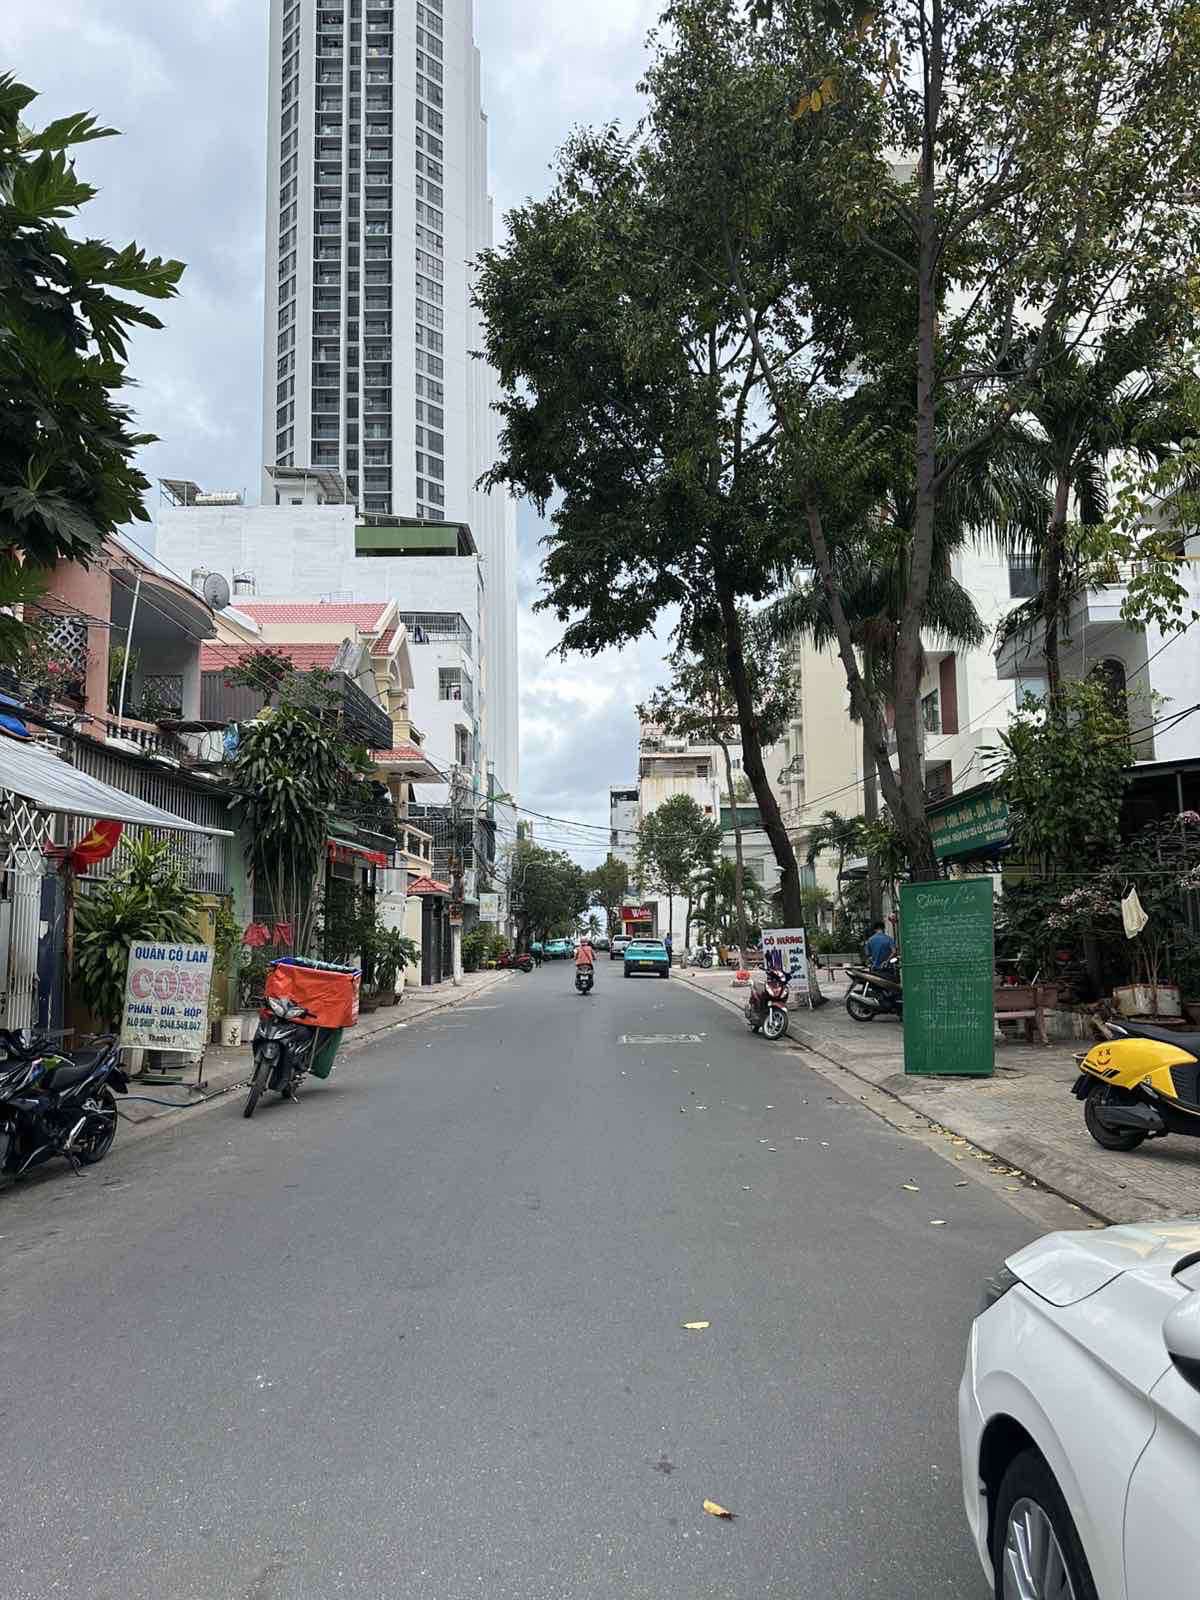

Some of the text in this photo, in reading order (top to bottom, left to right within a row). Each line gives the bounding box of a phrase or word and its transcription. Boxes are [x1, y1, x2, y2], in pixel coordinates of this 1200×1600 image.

[135, 945, 208, 963] QUÁN CÔ LAN
[131, 965, 209, 1001] CƠM
[128, 1002, 153, 1015] PHẦN
[184, 1006, 202, 1018] HỘP
[127, 1017, 140, 1028] ALO
